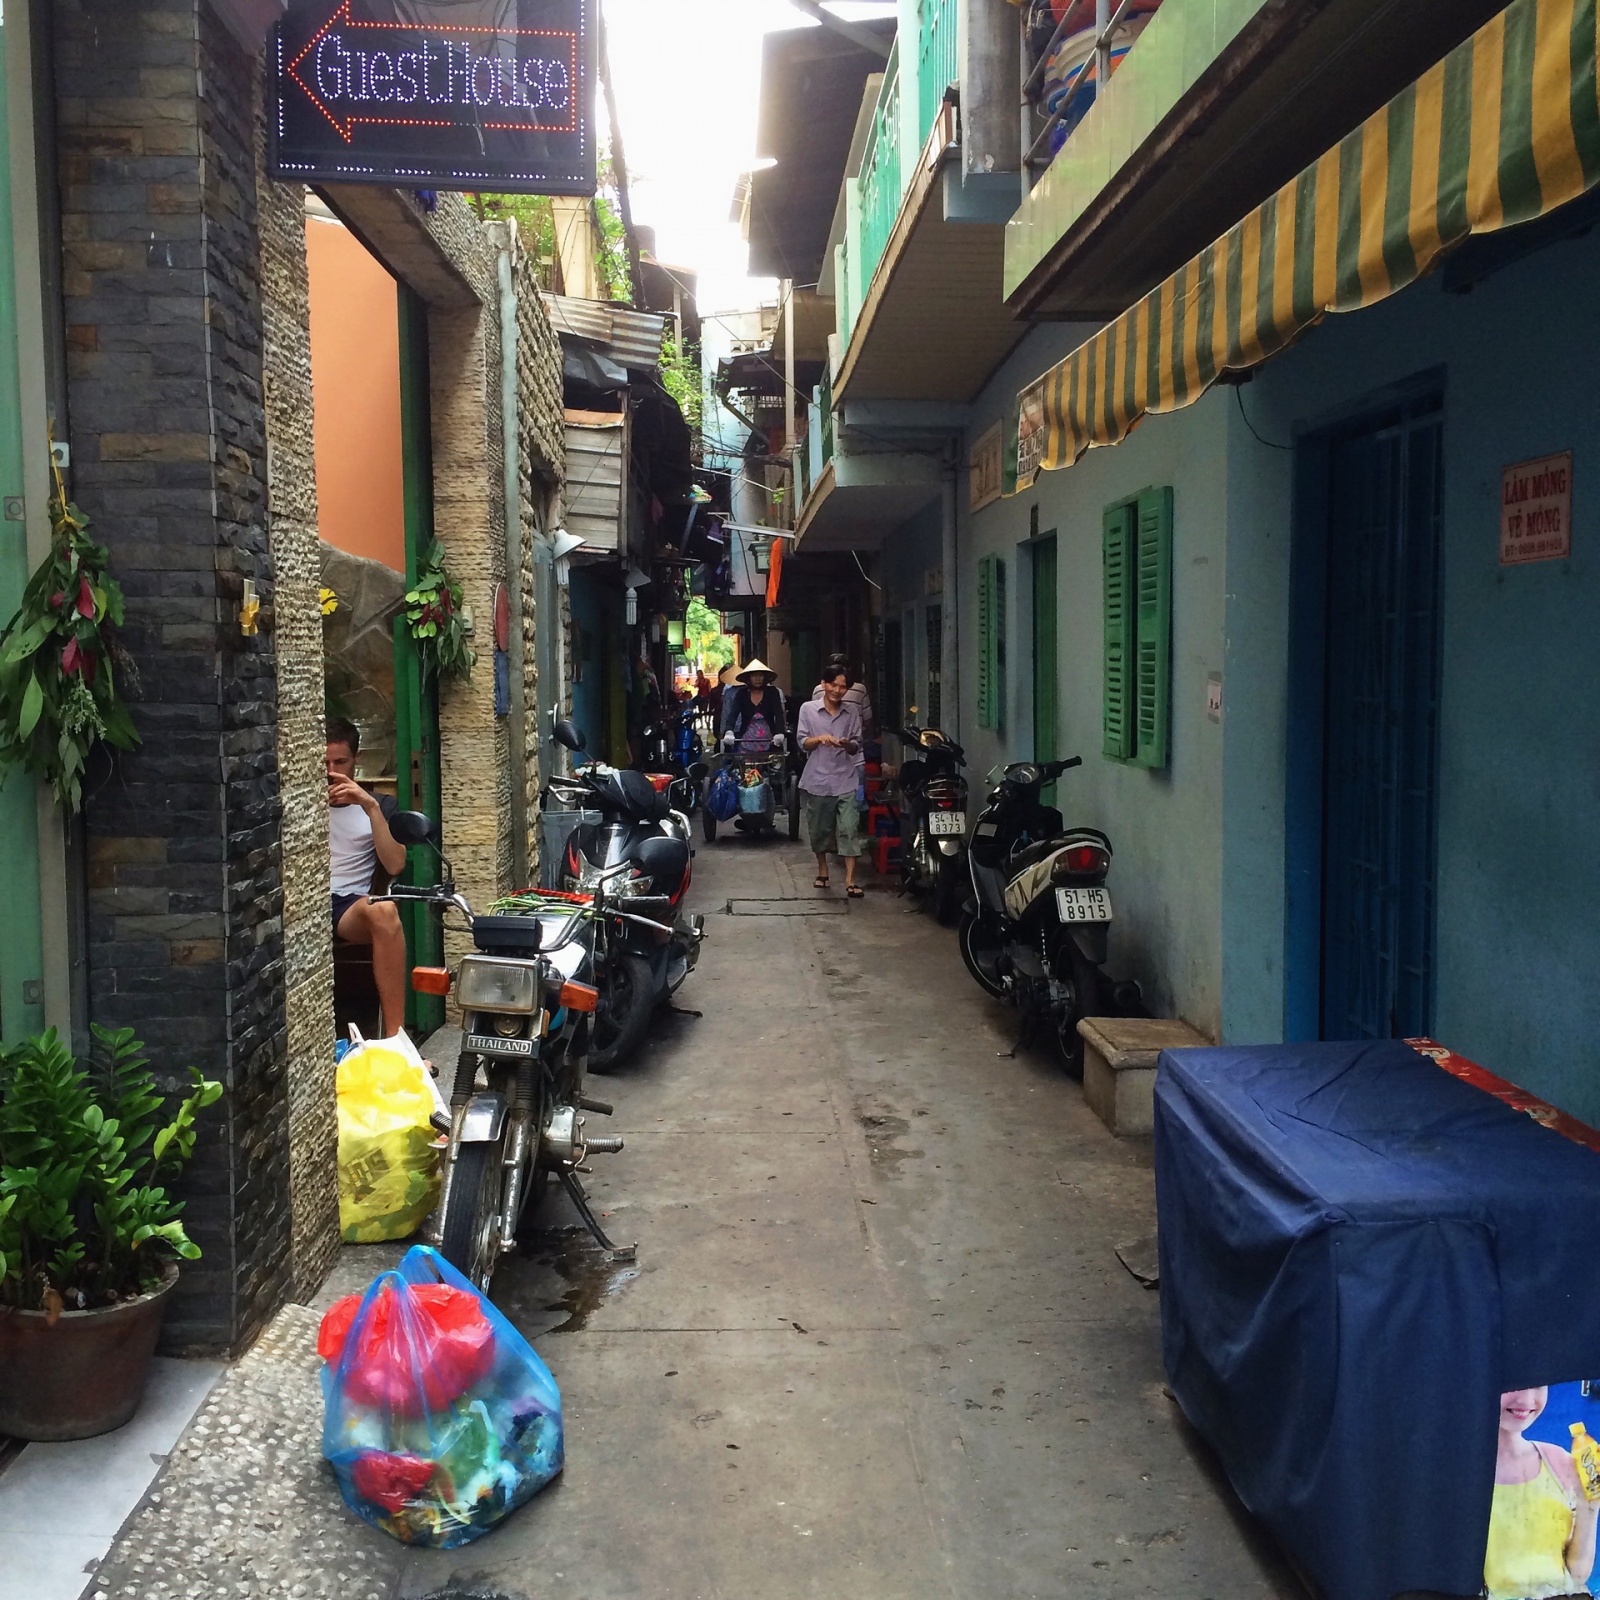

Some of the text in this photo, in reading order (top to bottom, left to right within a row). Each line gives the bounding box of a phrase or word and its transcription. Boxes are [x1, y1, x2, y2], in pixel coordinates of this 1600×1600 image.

[1532, 465, 1566, 499] MÓNG
[1526, 504, 1561, 537] MÓNG
[935, 824, 961, 833] 8373
[1064, 889, 1104, 904] 51-H5
[1067, 904, 1107, 920] 8915
[470, 1038, 529, 1052] THAILAND
